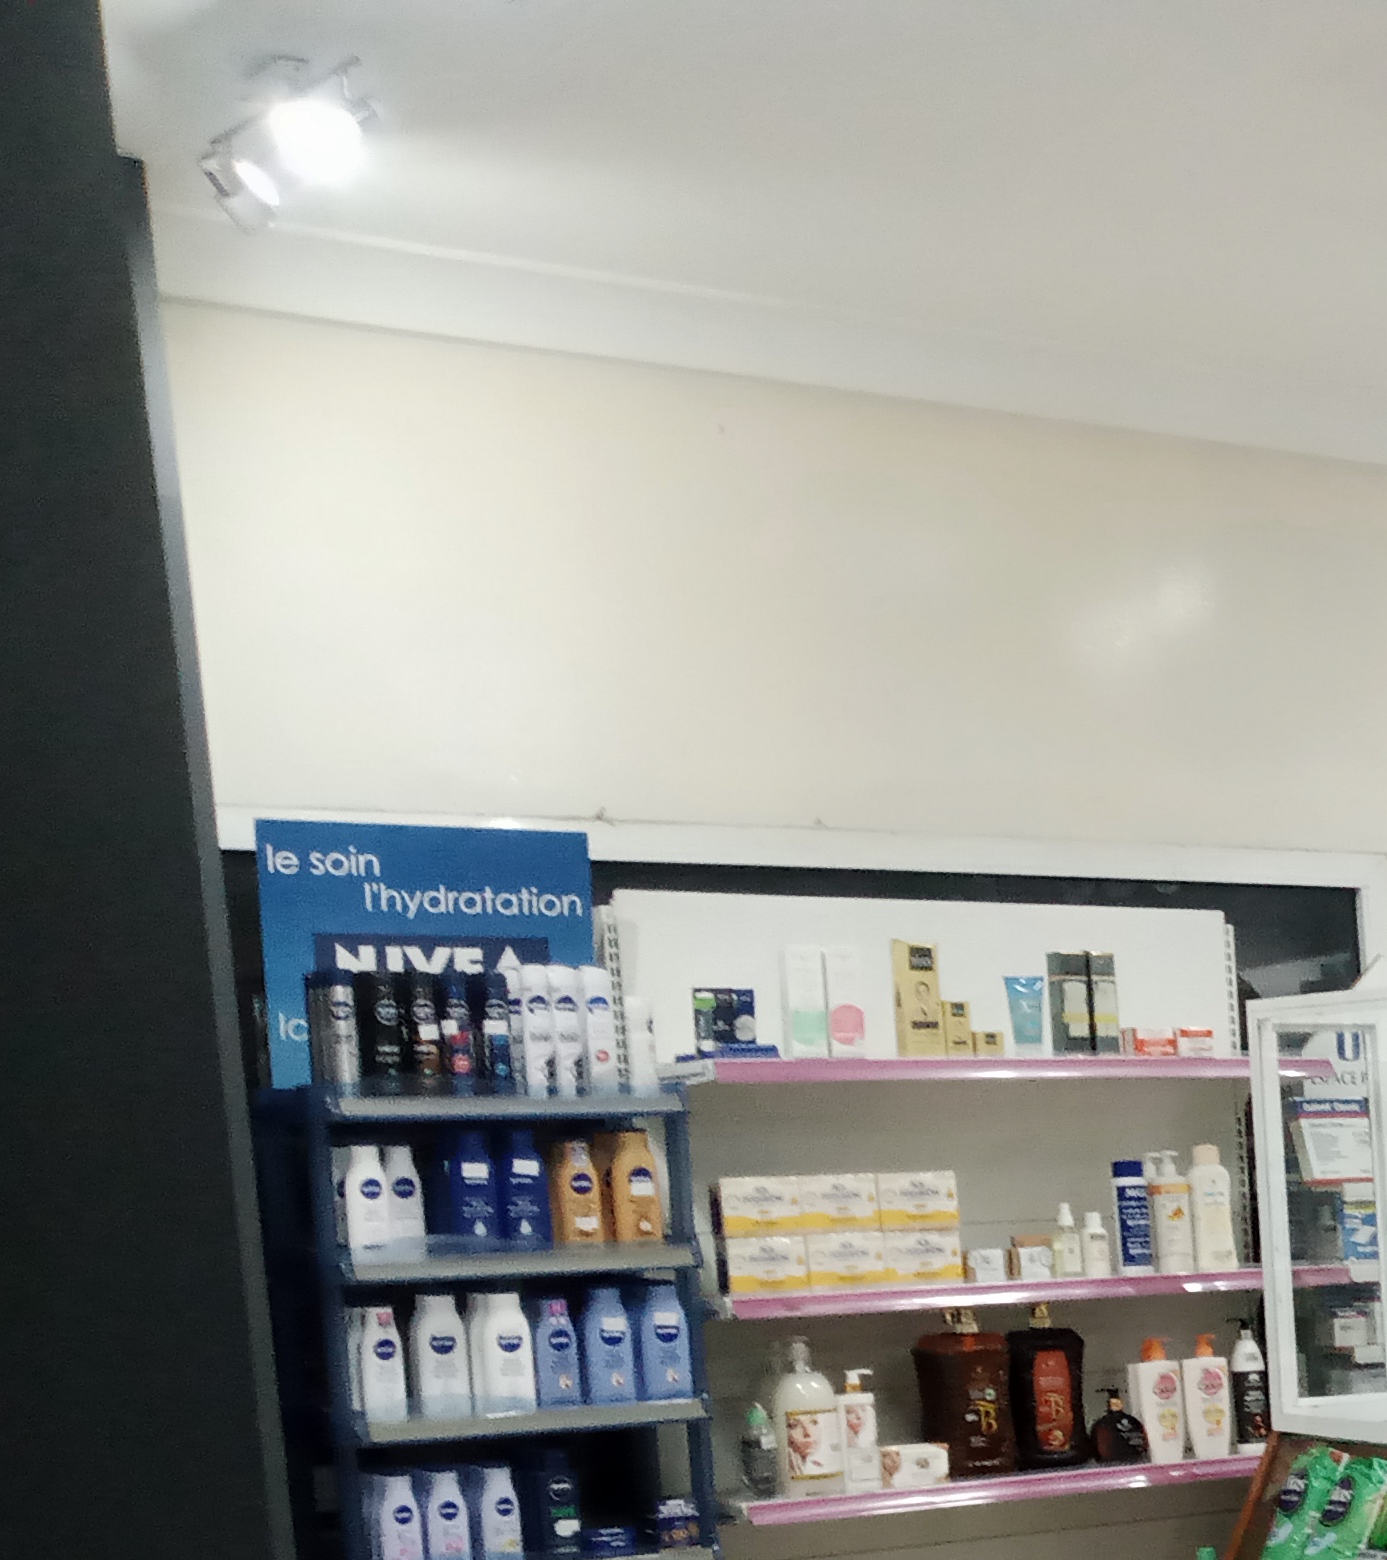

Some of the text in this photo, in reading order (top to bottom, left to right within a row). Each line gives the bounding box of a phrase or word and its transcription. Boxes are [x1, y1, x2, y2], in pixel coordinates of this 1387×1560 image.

[265, 843, 382, 878] le soin
[362, 881, 584, 920] l'hydratation
[334, 941, 522, 976] NIVEA
